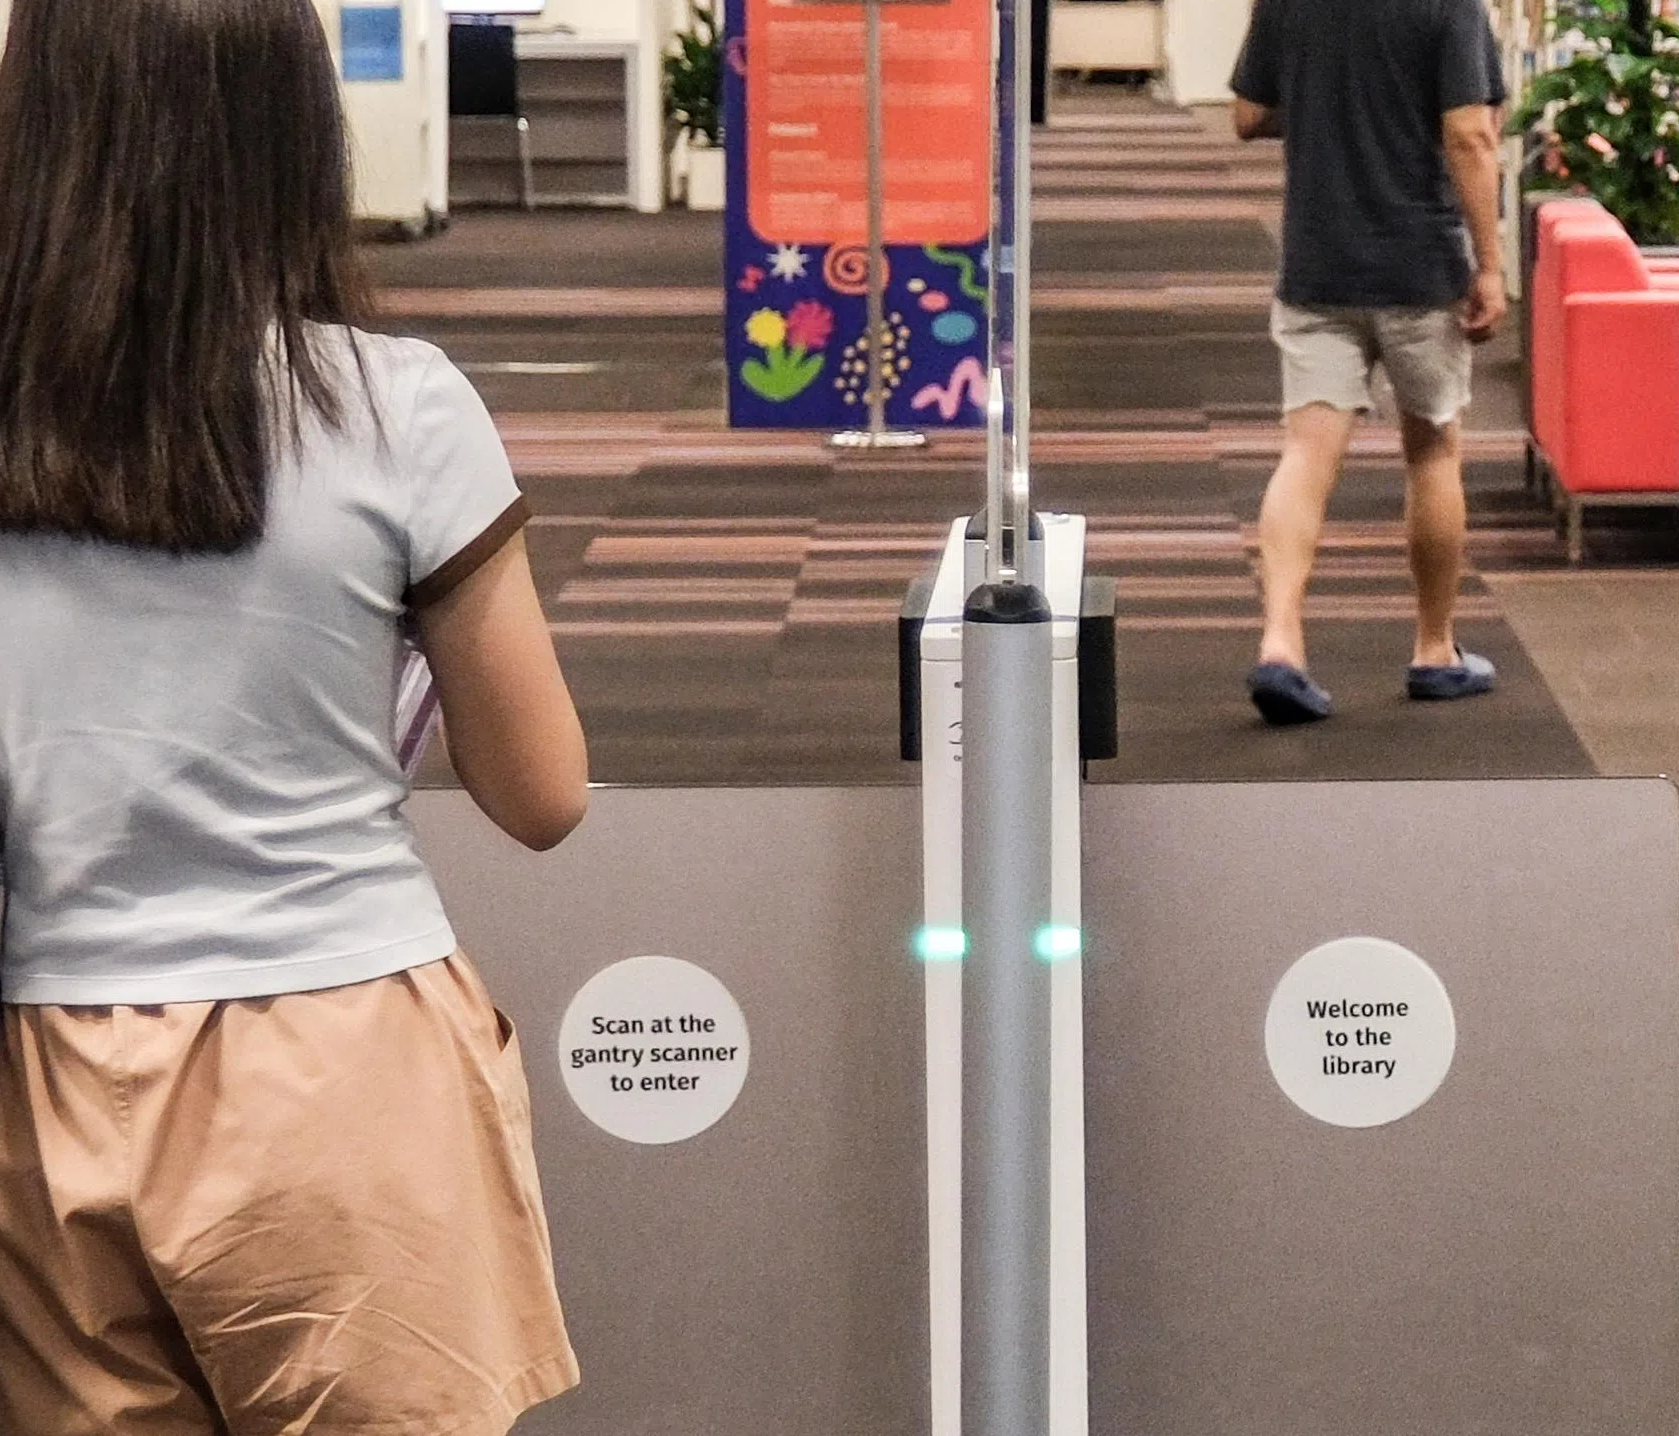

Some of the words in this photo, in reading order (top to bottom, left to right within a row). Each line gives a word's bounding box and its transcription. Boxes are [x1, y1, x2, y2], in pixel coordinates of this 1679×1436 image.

[1306, 998, 1409, 1019] Welcome
[592, 1016, 644, 1035] Scan
[650, 1016, 674, 1034] at
[678, 1013, 716, 1034] the
[1325, 1030, 1349, 1047] to
[1352, 1026, 1392, 1046] the
[571, 1046, 644, 1069] gantry
[650, 1046, 738, 1063] scanner
[1322, 1055, 1396, 1079] library
[610, 1075, 634, 1092] to
[640, 1073, 700, 1092] enter
